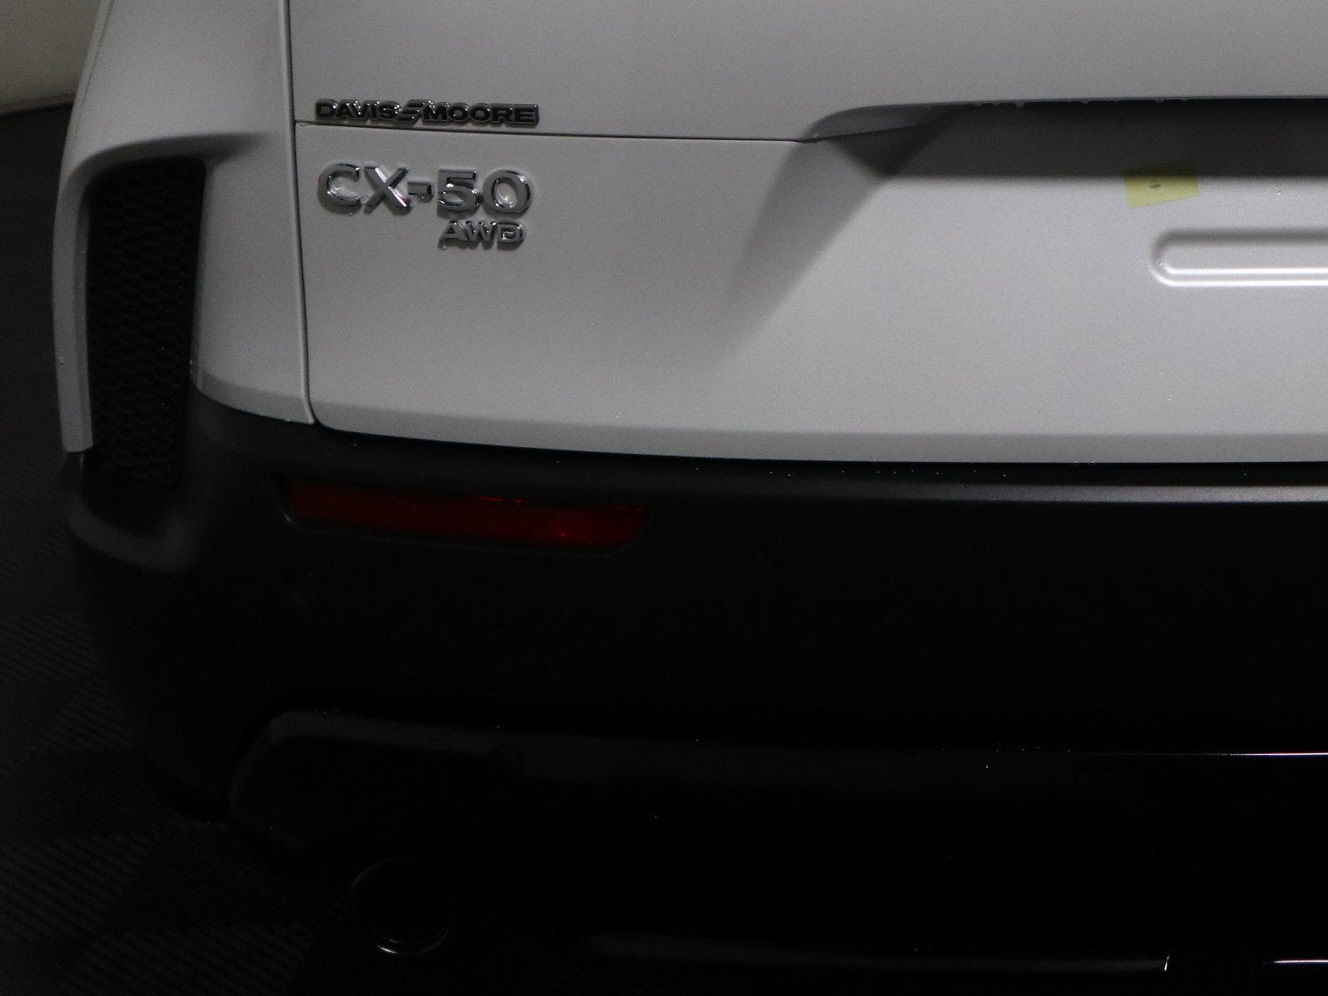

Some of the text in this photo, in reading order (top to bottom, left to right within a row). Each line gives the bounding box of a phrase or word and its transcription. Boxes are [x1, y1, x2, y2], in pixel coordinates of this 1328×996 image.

[315, 98, 540, 128] DAVIS MOORE
[317, 162, 535, 216] CX-50
[438, 219, 528, 249] AWD
